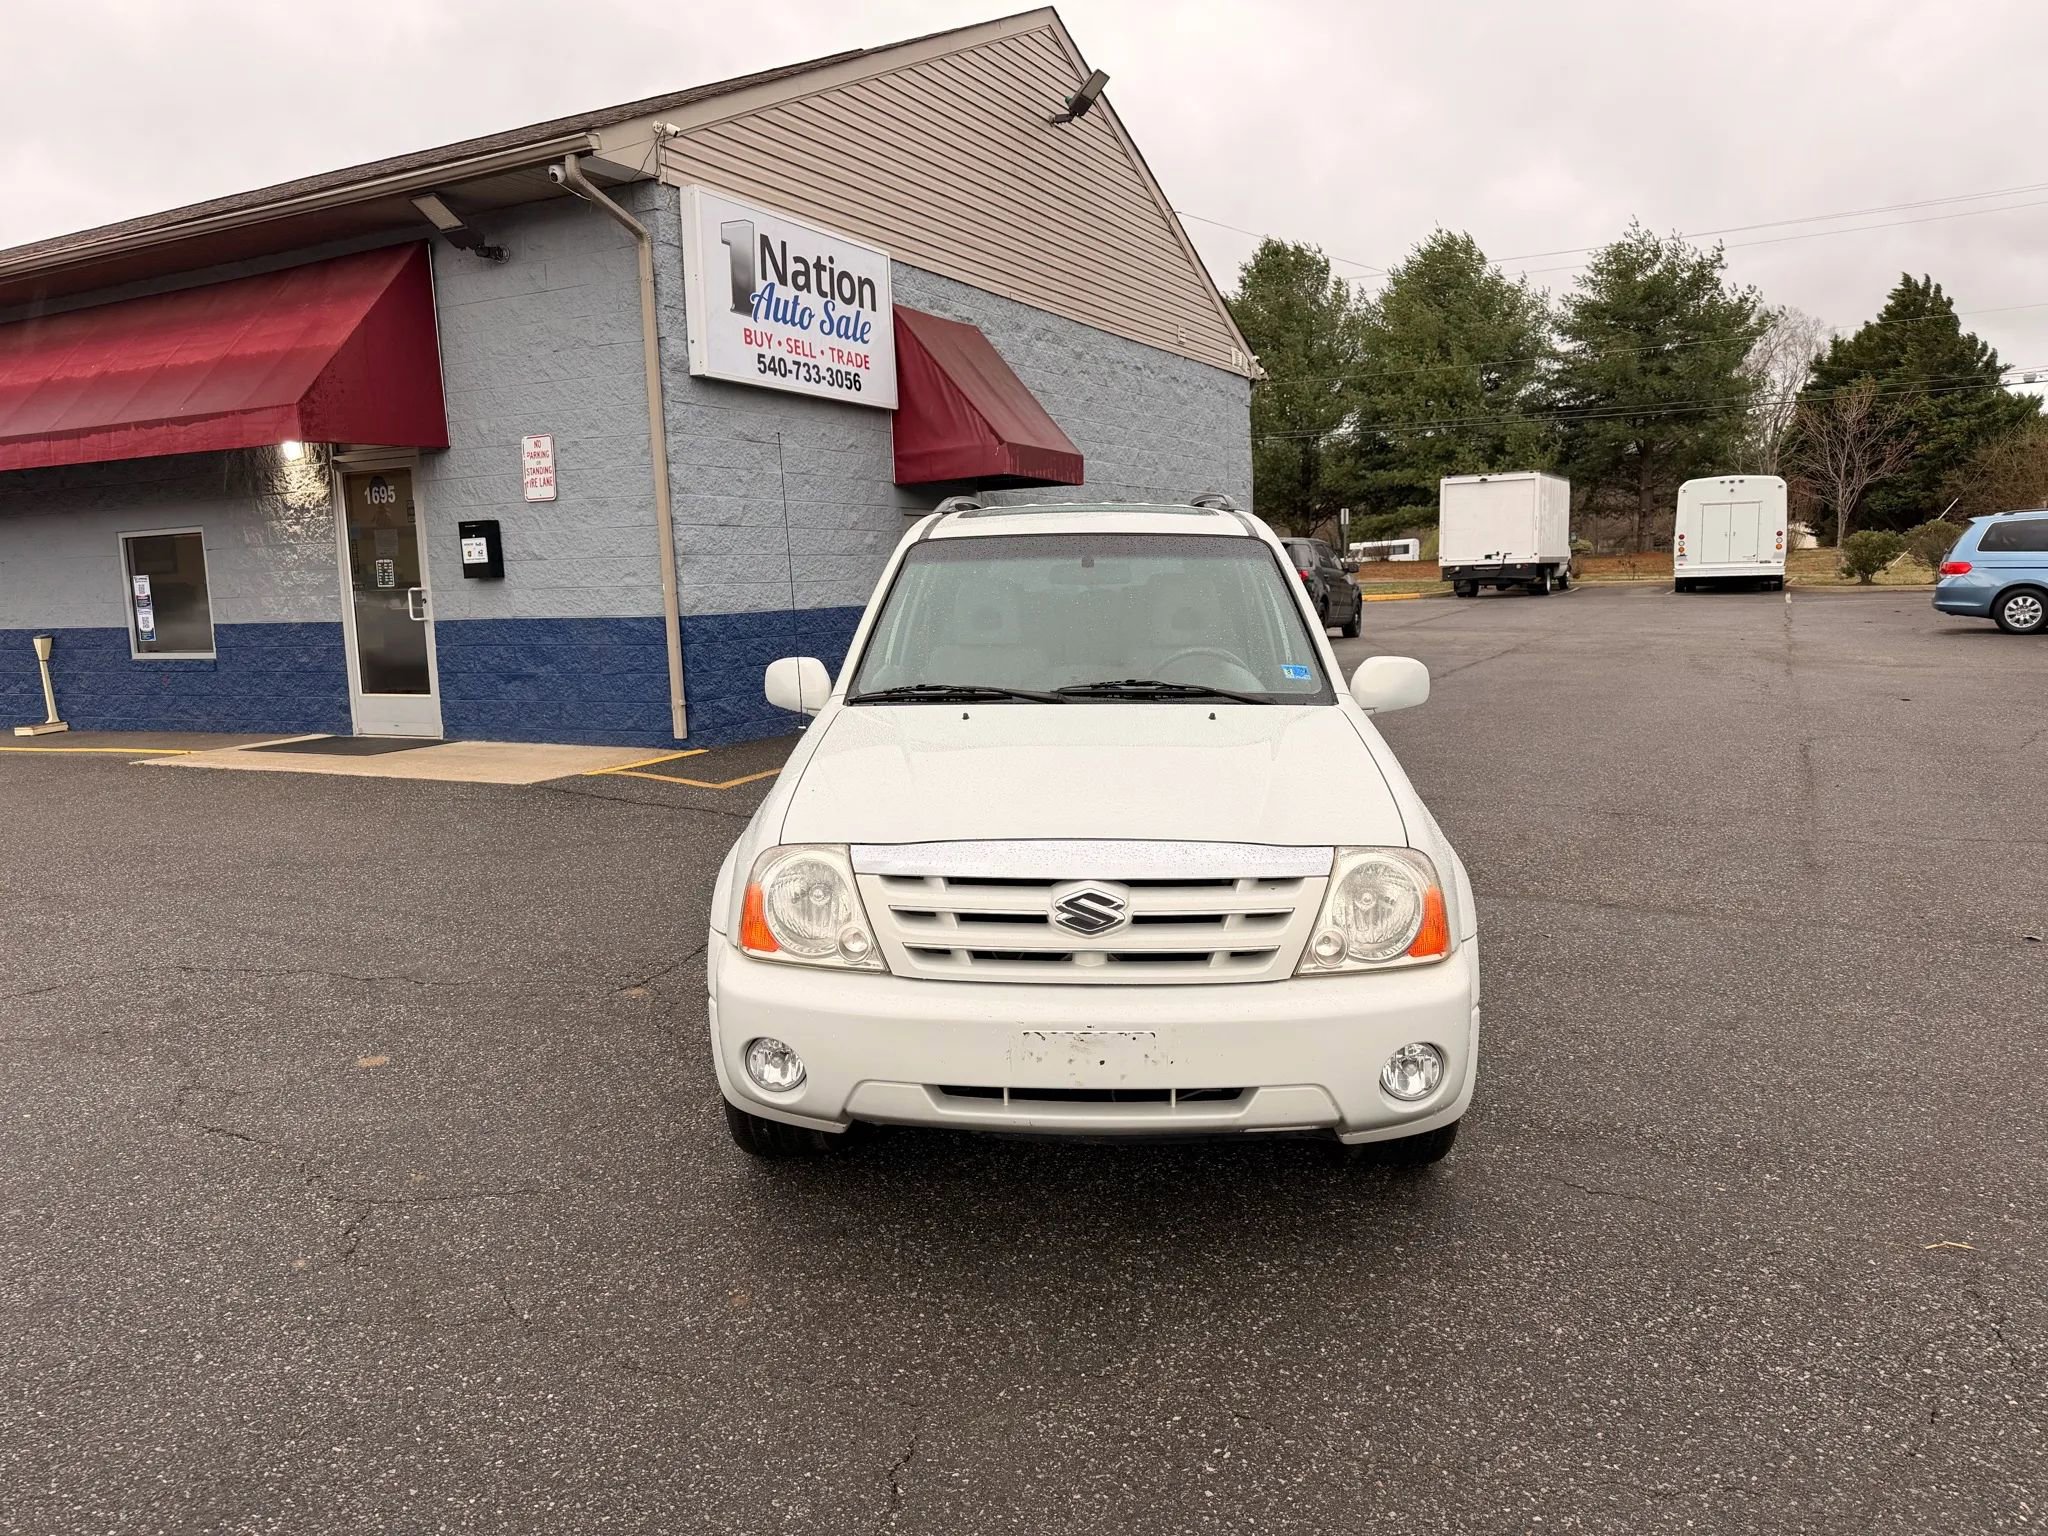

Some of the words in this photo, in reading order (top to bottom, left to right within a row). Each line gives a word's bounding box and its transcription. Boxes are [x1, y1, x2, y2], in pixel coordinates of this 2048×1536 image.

[721, 219, 756, 317] 1
[759, 233, 877, 312] Nation
[751, 282, 815, 330] Auto
[820, 300, 872, 344] Sale
[743, 328, 773, 349] BUY
[786, 338, 816, 359] SELL
[828, 346, 870, 370] TRADE
[757, 353, 862, 392] 540-733-3056
[533, 440, 542, 449] NO
[526, 450, 550, 460] PARKING
[526, 466, 553, 476] STANDING
[526, 478, 538, 488] FIRE
[539, 477, 553, 487] LANE
[364, 485, 396, 505] 1695
